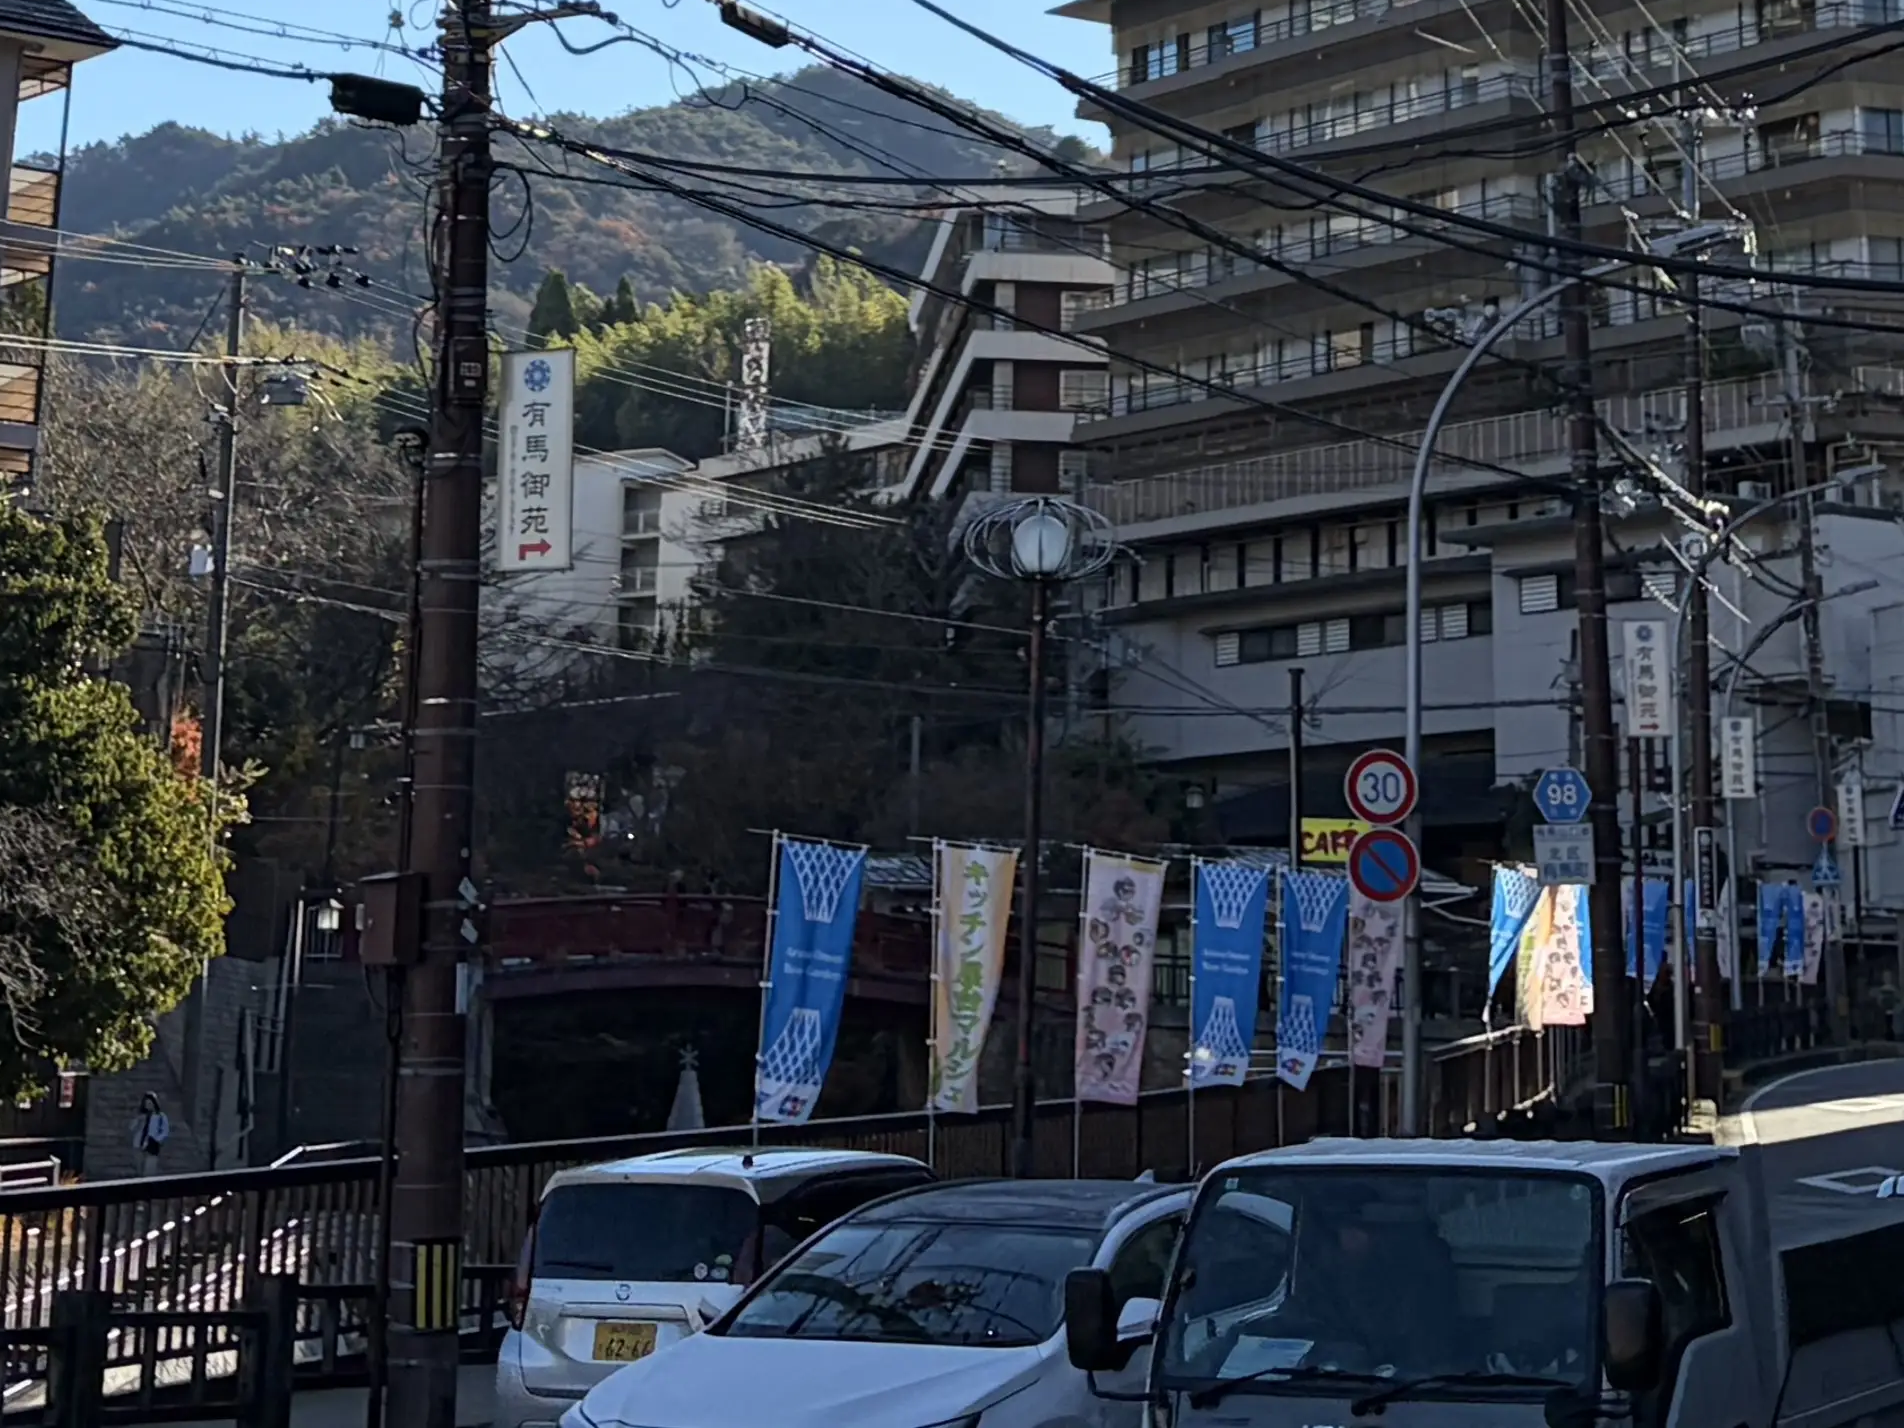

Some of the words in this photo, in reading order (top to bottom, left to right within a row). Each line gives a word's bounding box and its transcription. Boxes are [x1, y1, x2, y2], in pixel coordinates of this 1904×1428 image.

[520, 399, 552, 535] 有馬御苑
[1362, 772, 1401, 804] 30
[1546, 783, 1578, 805] 98
